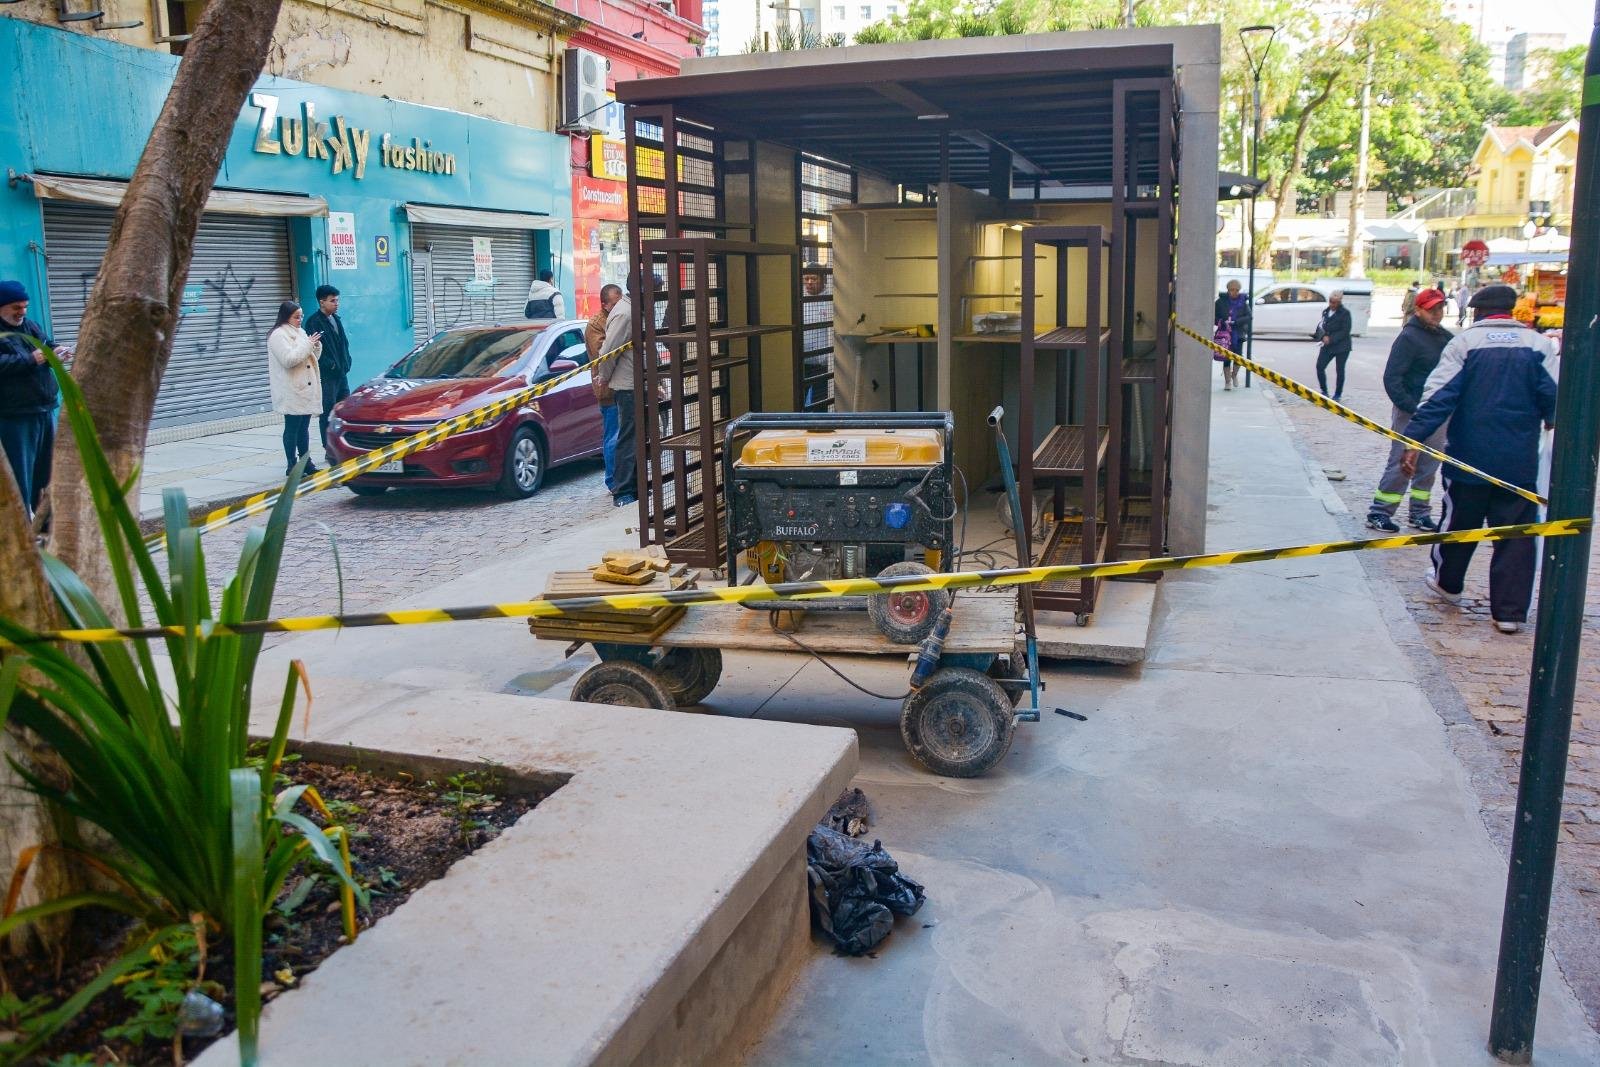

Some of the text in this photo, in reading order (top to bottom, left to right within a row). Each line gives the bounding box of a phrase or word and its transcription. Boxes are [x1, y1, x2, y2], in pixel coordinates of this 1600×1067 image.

[249, 92, 456, 179] Zukky fashion
[331, 233, 354, 245] ALUGA
[1463, 249, 1489, 258] PARE
[775, 525, 816, 536] BUFFALO
